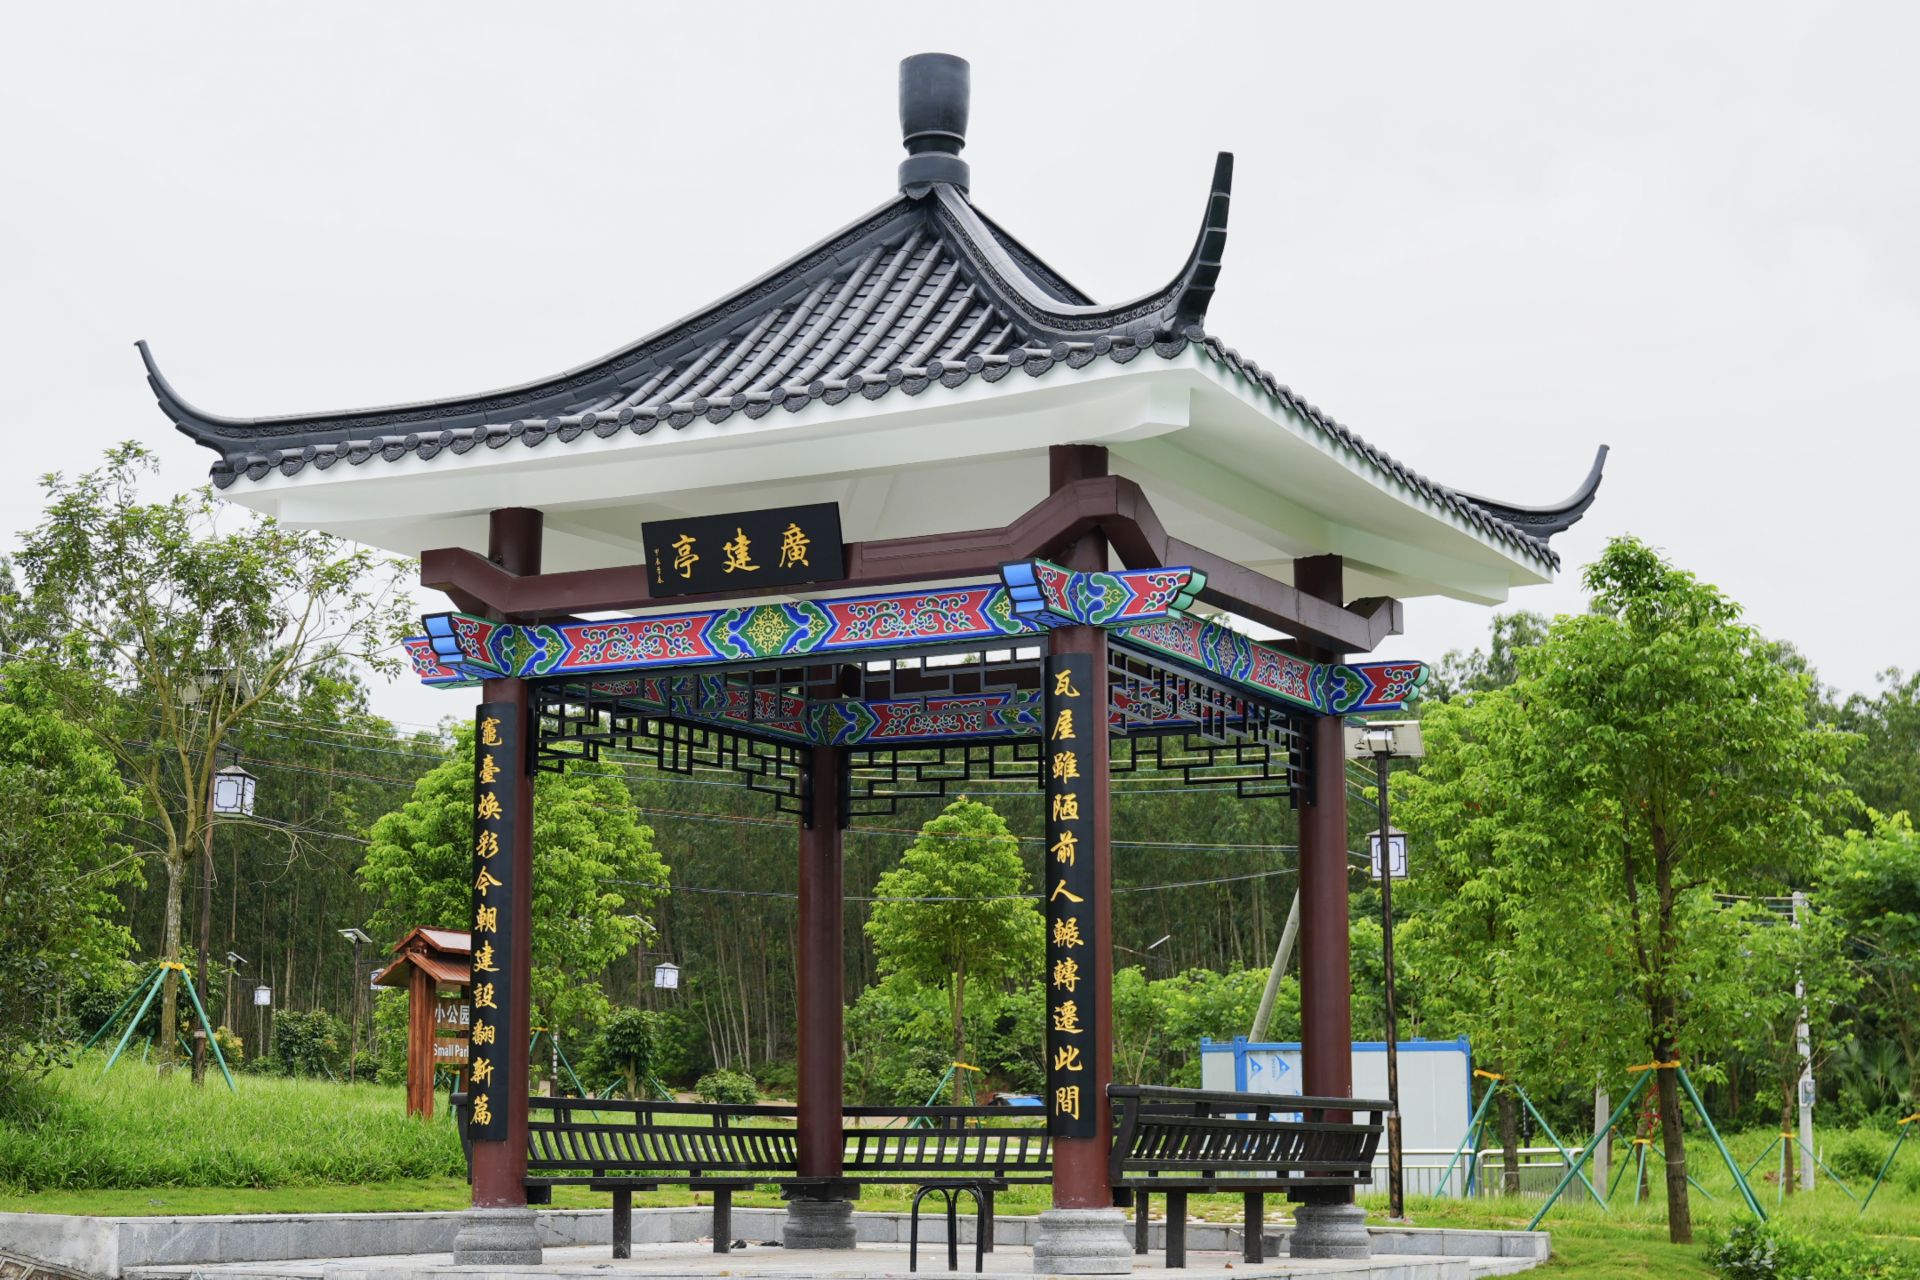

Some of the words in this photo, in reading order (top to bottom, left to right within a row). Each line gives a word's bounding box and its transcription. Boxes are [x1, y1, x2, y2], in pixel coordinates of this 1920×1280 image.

[1050, 669, 1084, 1121] 瓦屋雖陋前人輾轉遷此間
[435, 1003, 470, 1025] 小公园
[433, 1043, 454, 1057] Small
